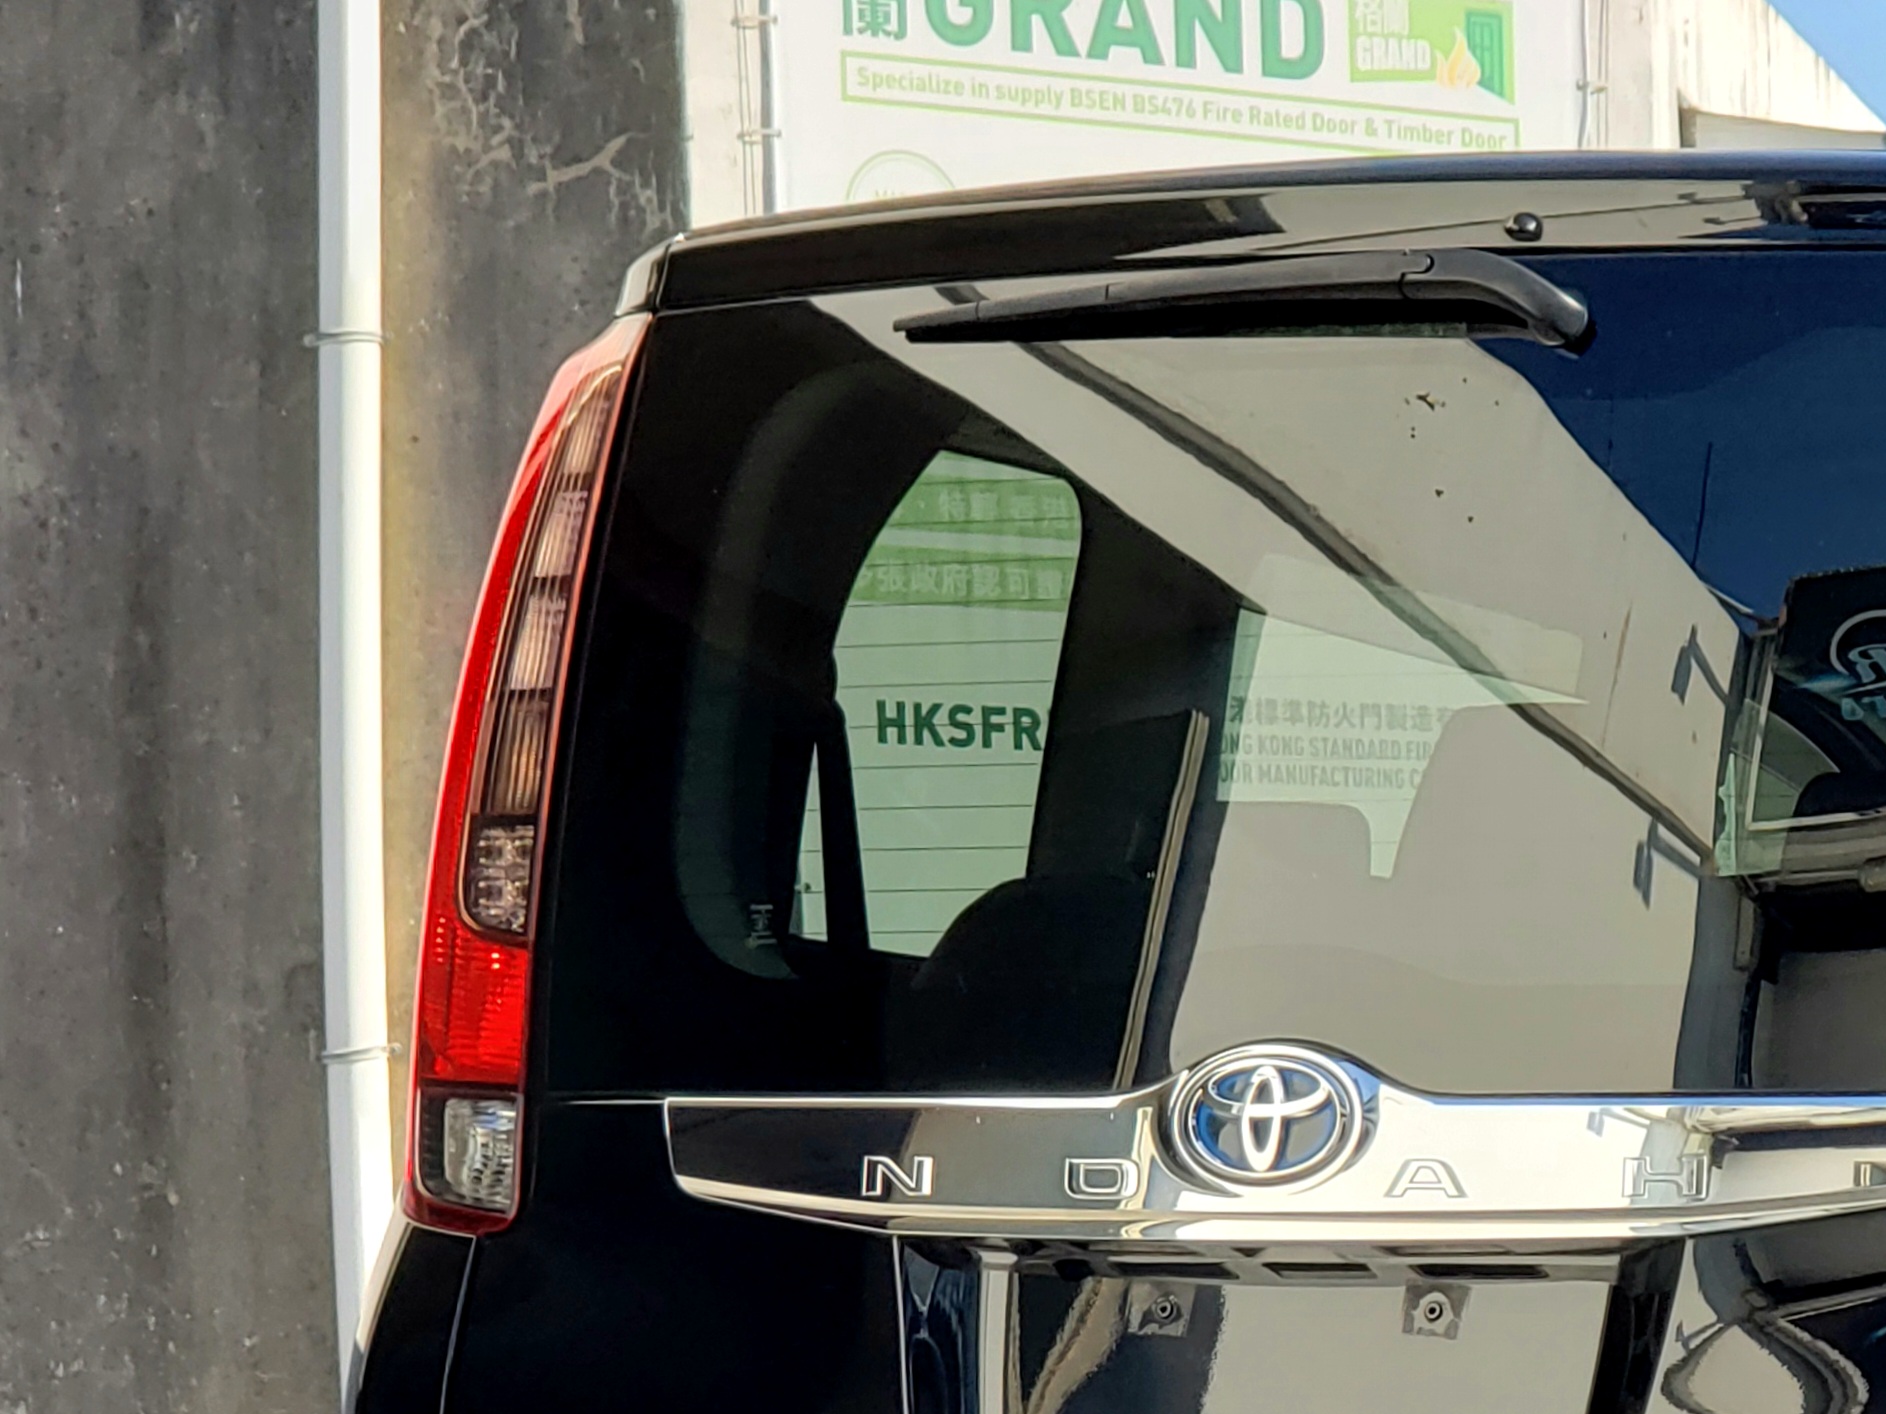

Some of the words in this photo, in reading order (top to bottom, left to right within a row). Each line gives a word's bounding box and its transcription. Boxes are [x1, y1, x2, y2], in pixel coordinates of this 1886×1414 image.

[924, 0, 1325, 80] GRAND
[1356, 35, 1431, 71] GRAND
[857, 67, 965, 97] Specialize
[970, 77, 989, 99] in
[996, 82, 1063, 110] supply
[1070, 87, 1126, 112] BSEN
[1133, 94, 1195, 118] BS476
[1203, 101, 1243, 124] Fire
[1249, 105, 1306, 129] Rated
[1312, 108, 1358, 135] Door
[1364, 117, 1378, 137] &
[1384, 119, 1453, 146] Timber
[1461, 128, 1507, 150] Door
[876, 699, 1050, 751] HKSFR
[1220, 733, 1252, 756] ONG
[1258, 735, 1304, 758] KONG
[1309, 737, 1401, 761] STANDARD
[1406, 741, 1435, 762] FIR
[1220, 760, 1253, 784] OOR
[1258, 764, 1405, 790] MANUFACTURING
